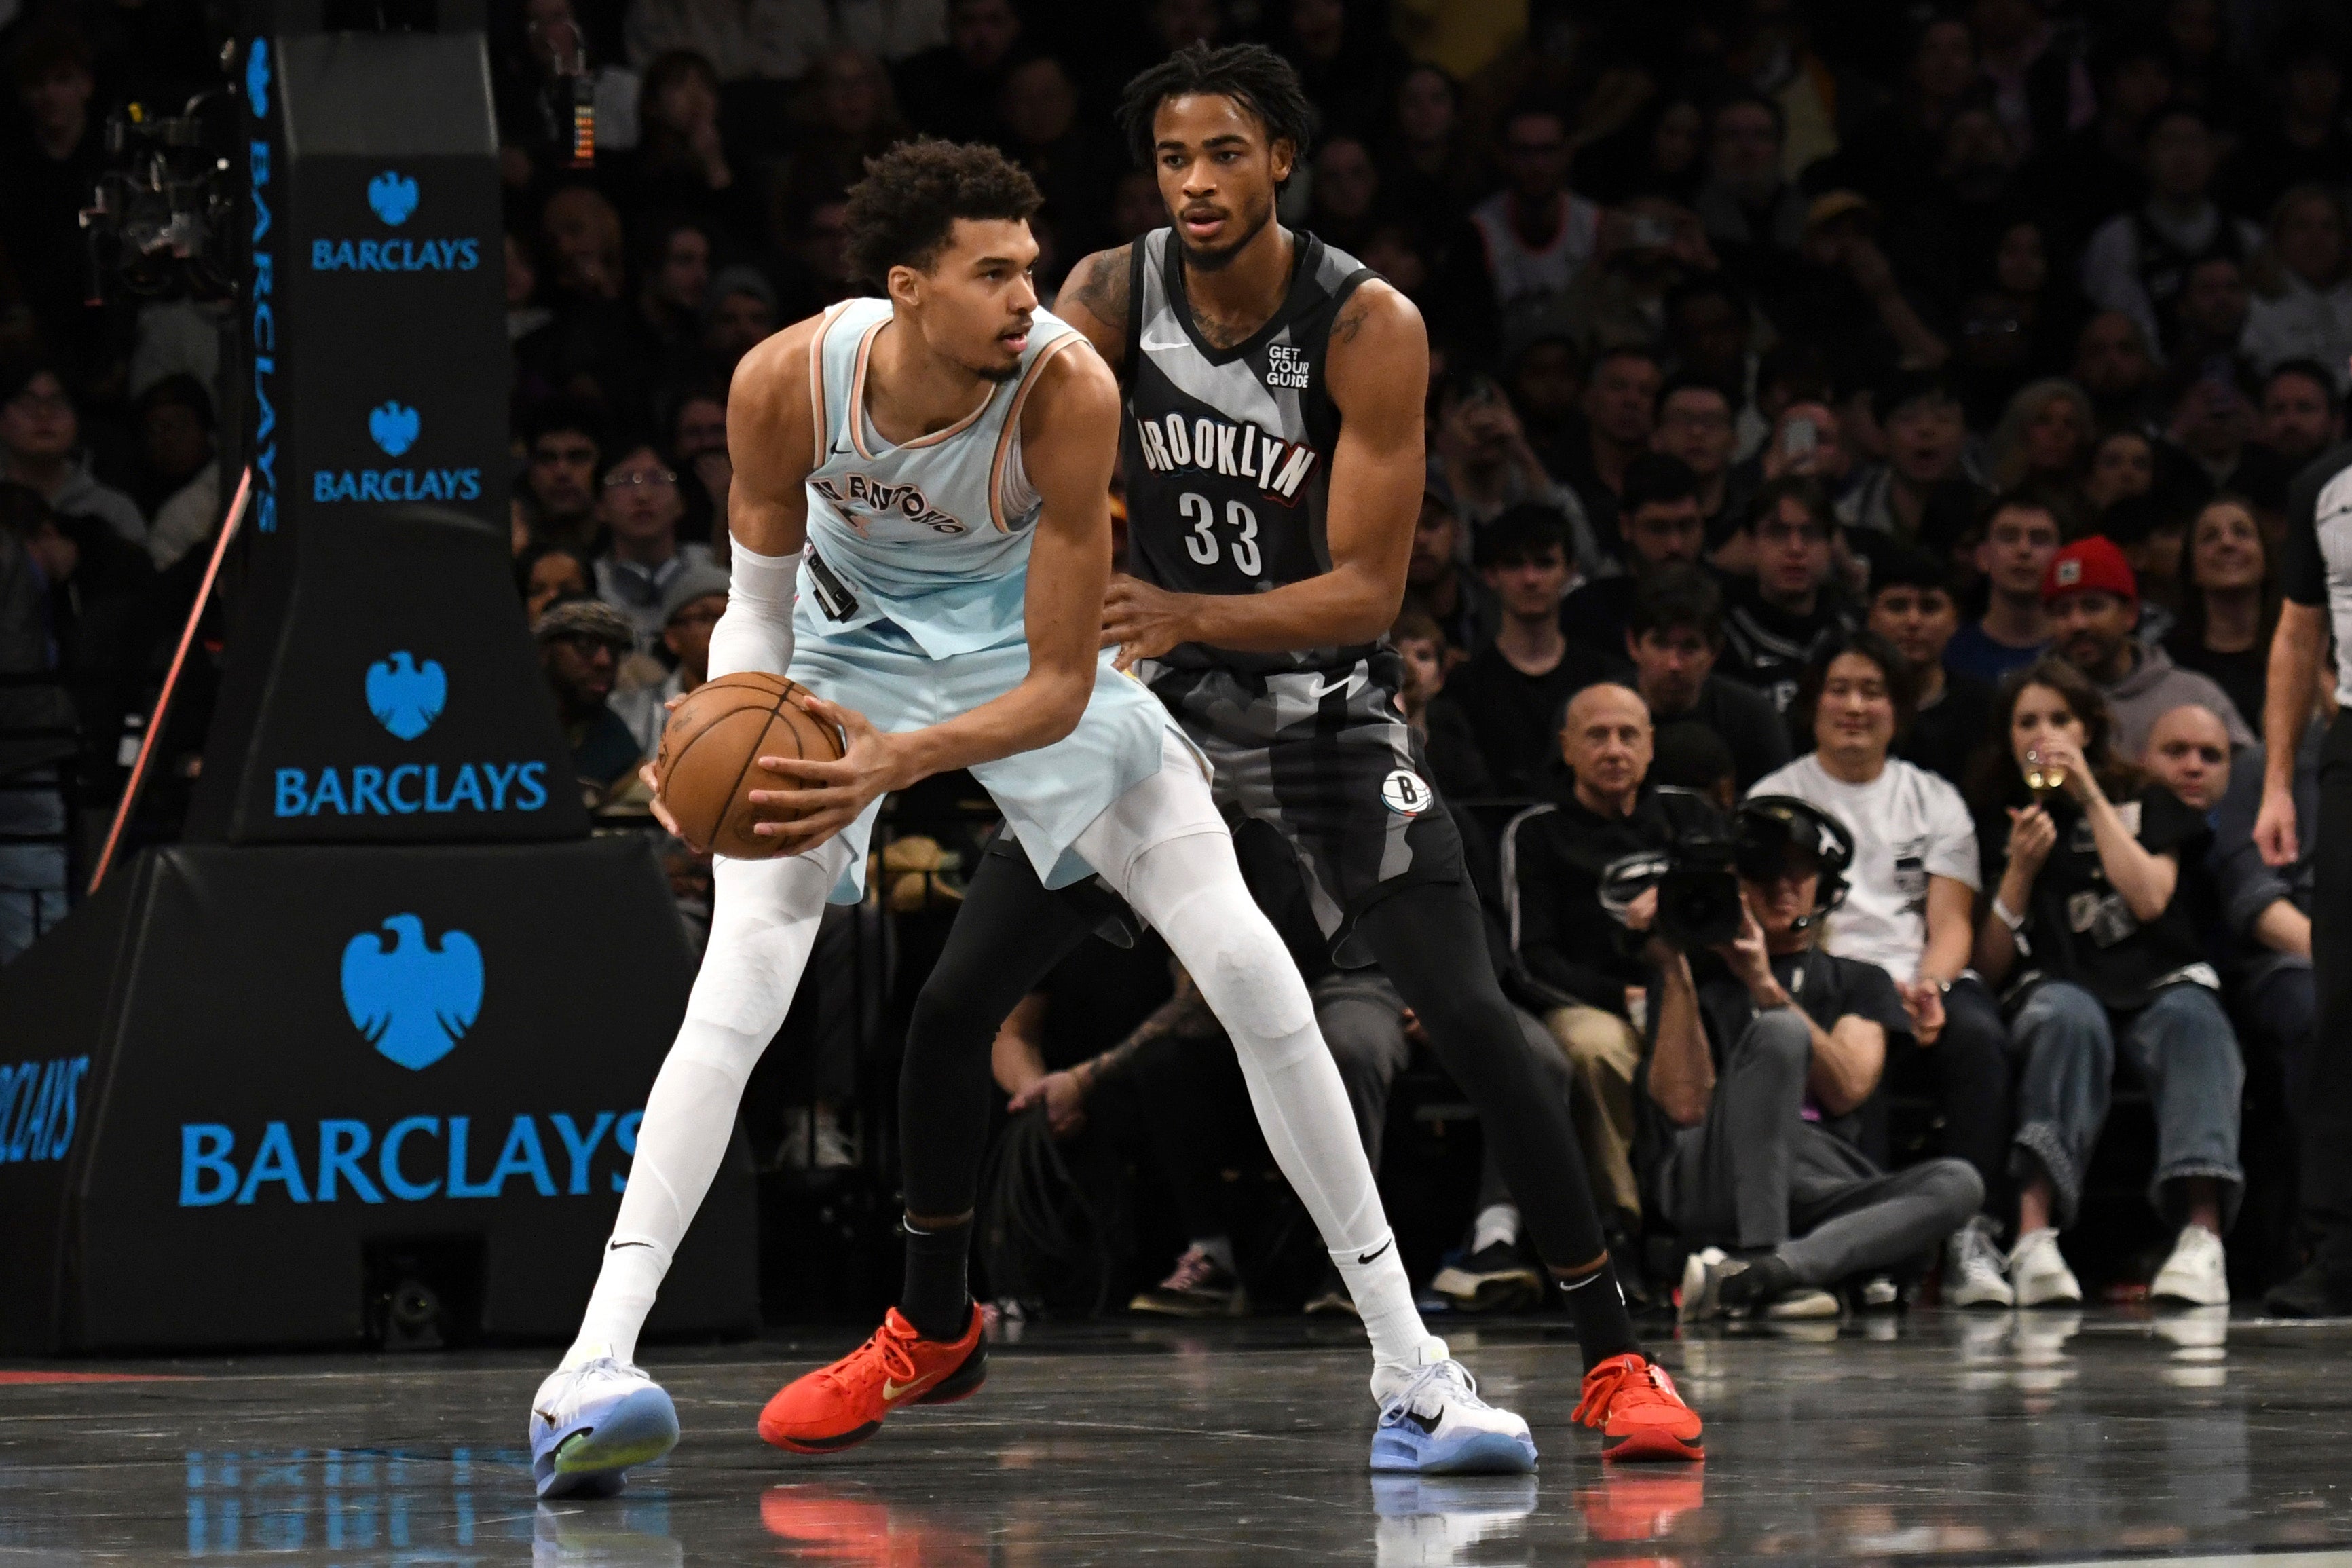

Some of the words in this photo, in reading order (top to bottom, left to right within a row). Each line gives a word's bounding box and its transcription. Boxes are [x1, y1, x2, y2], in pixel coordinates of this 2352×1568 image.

[311, 238, 479, 272] BARCLAYS
[249, 141, 277, 532] BARCLAYS
[1269, 346, 1301, 360] GET
[1266, 372, 1309, 388] GUIDE
[1269, 358, 1309, 375] YOUR
[1136, 413, 1315, 498] BROOKLYN
[313, 468, 481, 503] BARCLAYS
[848, 475, 965, 534] ANTONIO
[1178, 492, 1262, 576] 33
[274, 760, 548, 818] BARCLAYS
[1397, 775, 1419, 804] B
